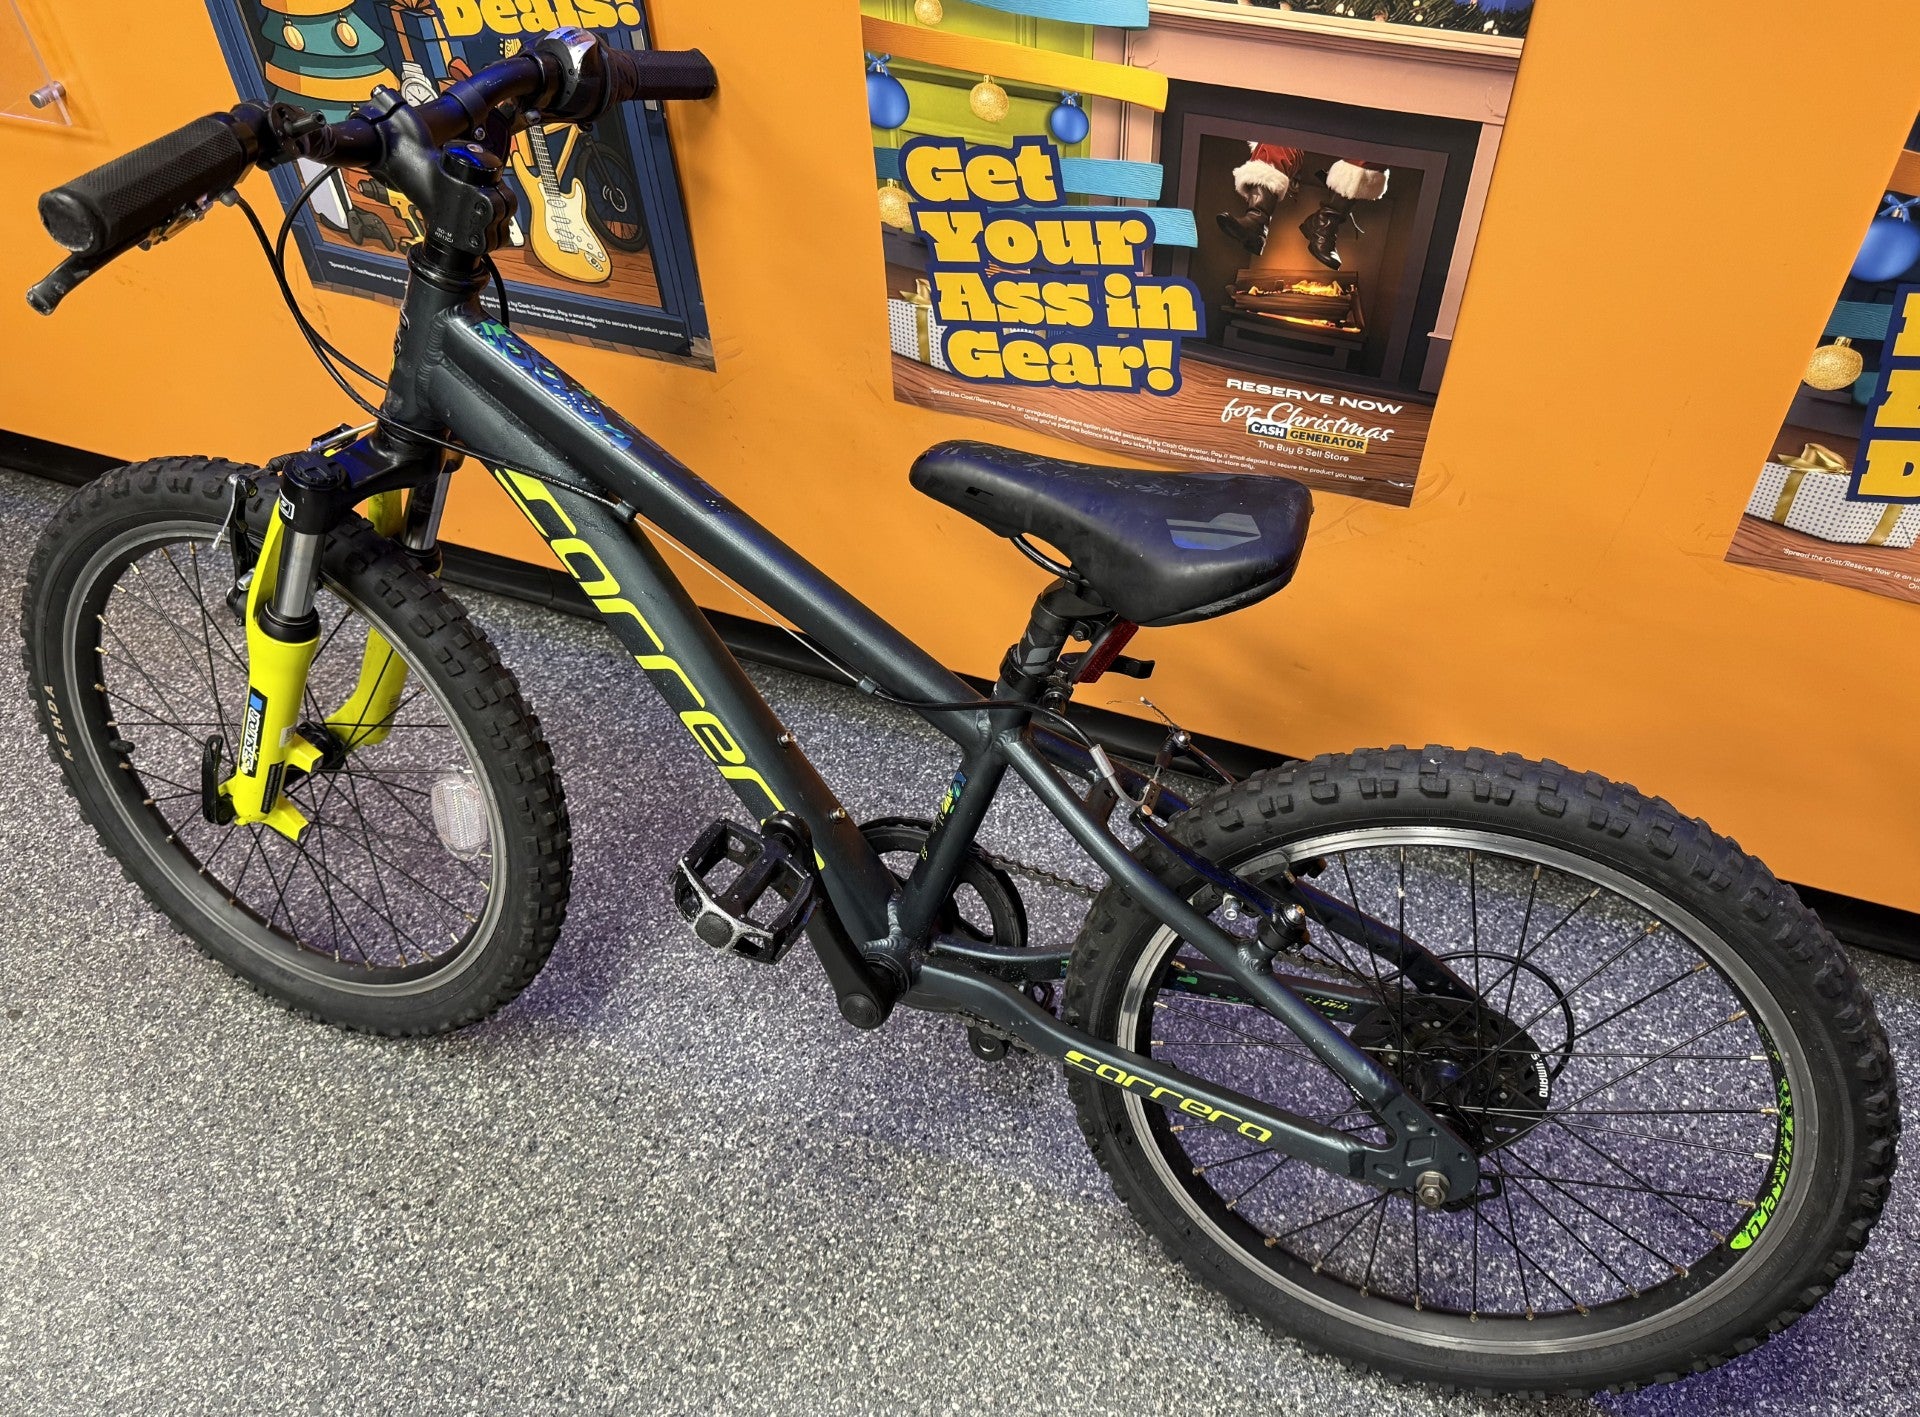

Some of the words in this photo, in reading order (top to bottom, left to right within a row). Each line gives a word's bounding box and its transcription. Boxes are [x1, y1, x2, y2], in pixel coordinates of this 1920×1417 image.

[905, 145, 1058, 202] Get
[917, 211, 1148, 266] Your
[542, 313, 564, 321] Available
[557, 309, 568, 317] Pay
[934, 272, 1094, 327] Ass
[1104, 273, 1198, 331] in
[947, 329, 1174, 391] Gear!
[1221, 398, 1261, 423] for
[1267, 402, 1395, 441] Christmas
[1226, 378, 1334, 405] RESERVE
[1340, 396, 1402, 415] NOW
[950, 390, 960, 398] the
[1025, 408, 1057, 420] unregulated
[1058, 416, 1082, 426] payment
[1083, 421, 1100, 431] option
[1102, 427, 1121, 436] offered
[1123, 432, 1152, 445] exclusively
[1153, 438, 1160, 446] by
[1161, 440, 1178, 450] Cash
[1178, 444, 1209, 455] Generator.
[1211, 450, 1222, 459] Pay
[1246, 457, 1268, 466] deposit
[1277, 462, 1297, 470] secure
[1309, 467, 1334, 477] product
[1348, 474, 1366, 482] want.
[1023, 413, 1038, 422] Once
[1039, 418, 1057, 427] you've
[1058, 422, 1070, 430] paid
[1071, 425, 1080, 433] the
[1080, 428, 1102, 439] balance
[1121, 438, 1132, 446] you
[1133, 441, 1145, 449] take
[1157, 446, 1169, 455] item
[1170, 449, 1187, 458] home.
[1189, 453, 1215, 463] Available
[1217, 457, 1239, 467] in-store
[1240, 462, 1255, 470] only.
[1251, 422, 1285, 437] CASH
[1290, 430, 1364, 449] GENERATOR
[1257, 440, 1275, 450] The
[1277, 443, 1295, 455] Buy
[1297, 446, 1304, 455] &
[1306, 448, 1322, 458] Sell
[1324, 450, 1350, 462] Store
[1811, 553, 1823, 561] the
[1824, 556, 1873, 572] Cost/Reserve
[1894, 571, 1901, 579] is
[495, 468, 826, 870] carrer
[43, 685, 74, 762] KENDA
[1064, 1050, 1273, 1143] carrera
